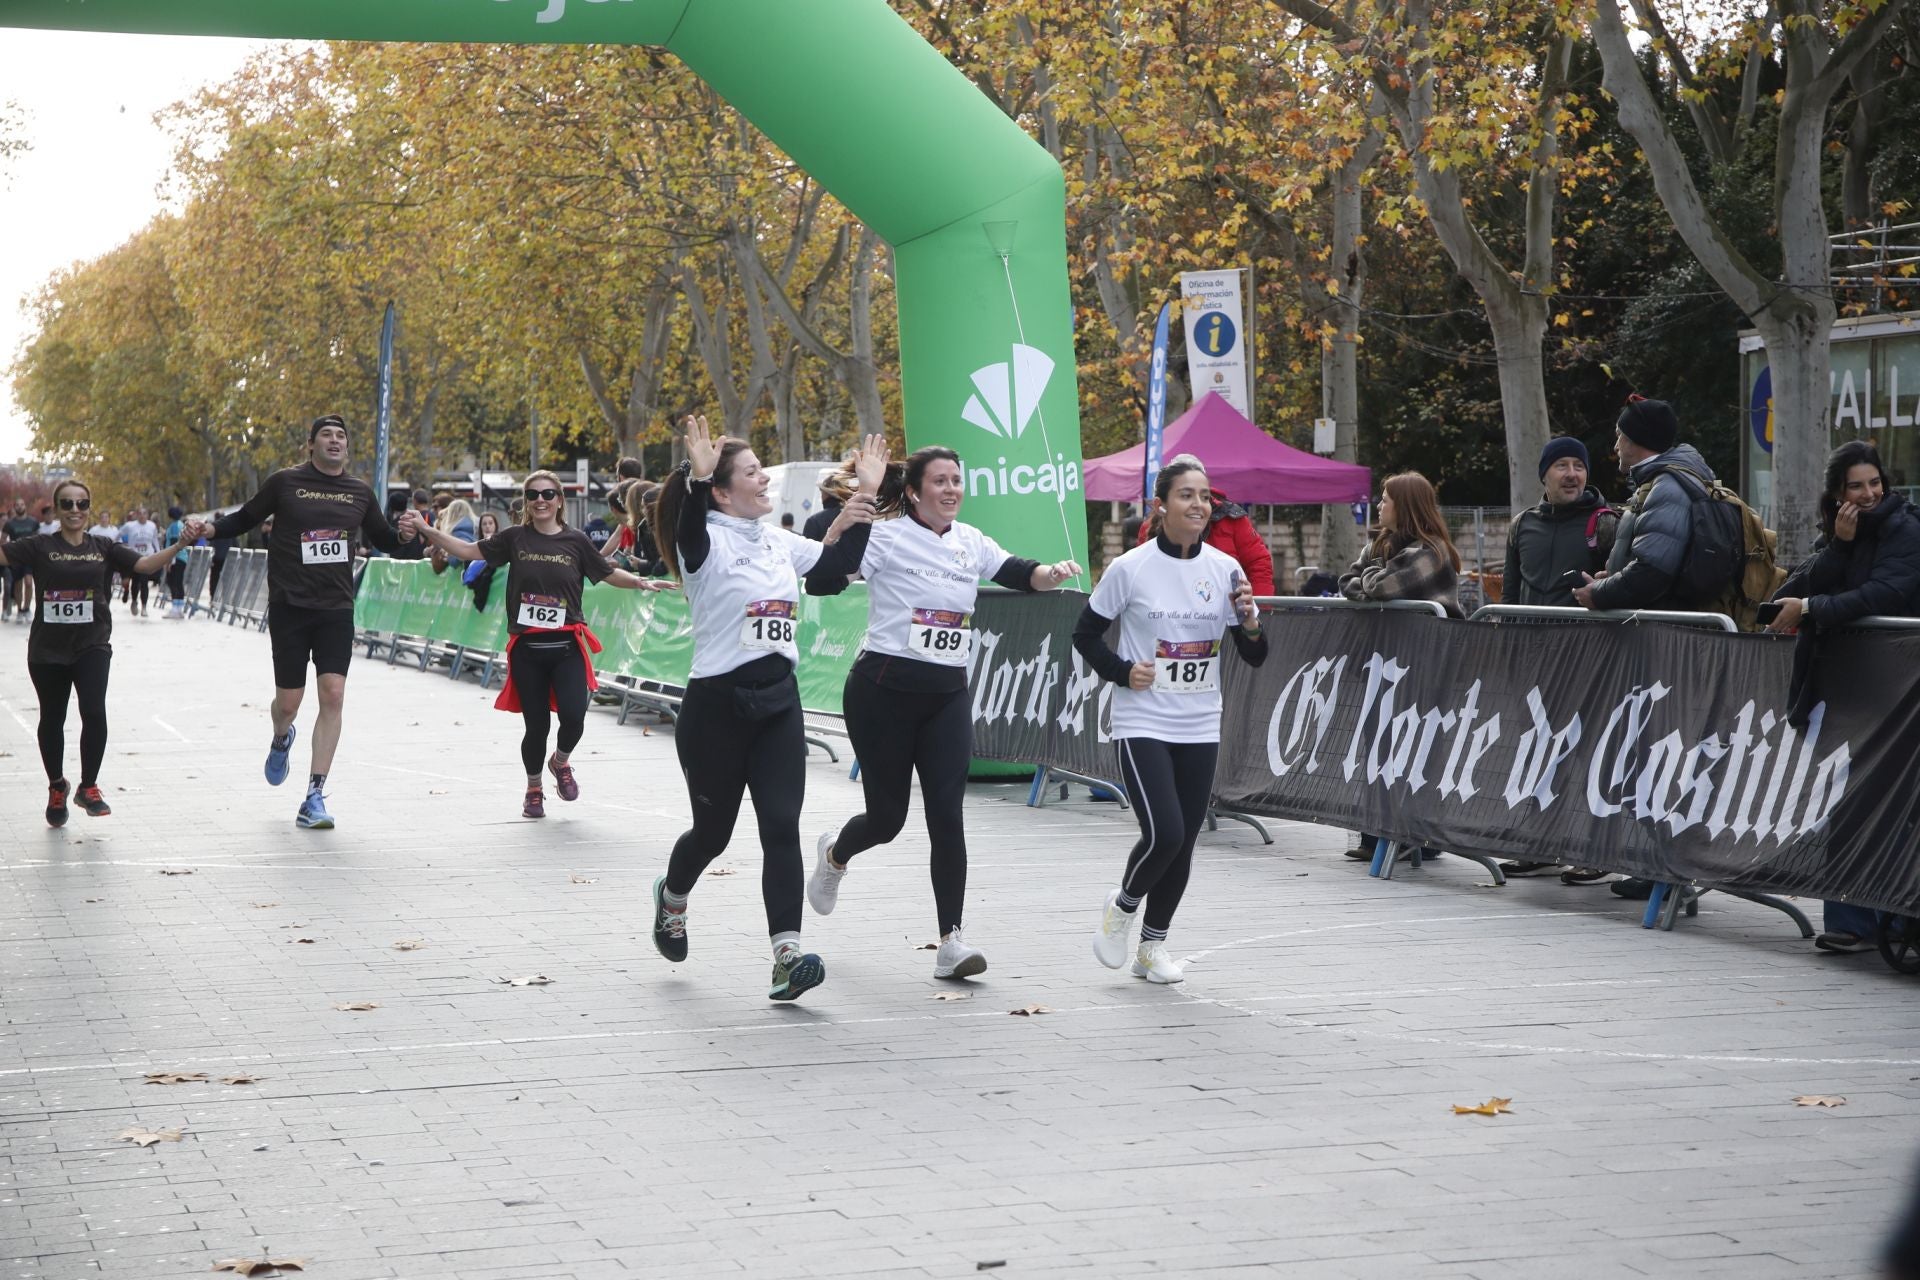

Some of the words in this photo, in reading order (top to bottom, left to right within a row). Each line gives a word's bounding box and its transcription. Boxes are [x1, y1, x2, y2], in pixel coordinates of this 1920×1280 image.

[1188, 280, 1213, 289] Oficina
[1215, 279, 1224, 287] de
[309, 541, 341, 557] 160
[51, 602, 84, 617] 161
[527, 606, 558, 622] 162
[1147, 611, 1165, 620] CEIP
[1167, 611, 1181, 619] Villa
[1182, 611, 1192, 619] del
[751, 618, 792, 643] 188
[920, 627, 962, 651] 189
[1166, 661, 1210, 683] 187
[1266, 655, 1348, 777] El
[1342, 651, 1501, 804] Norte
[1502, 685, 1582, 812] de
